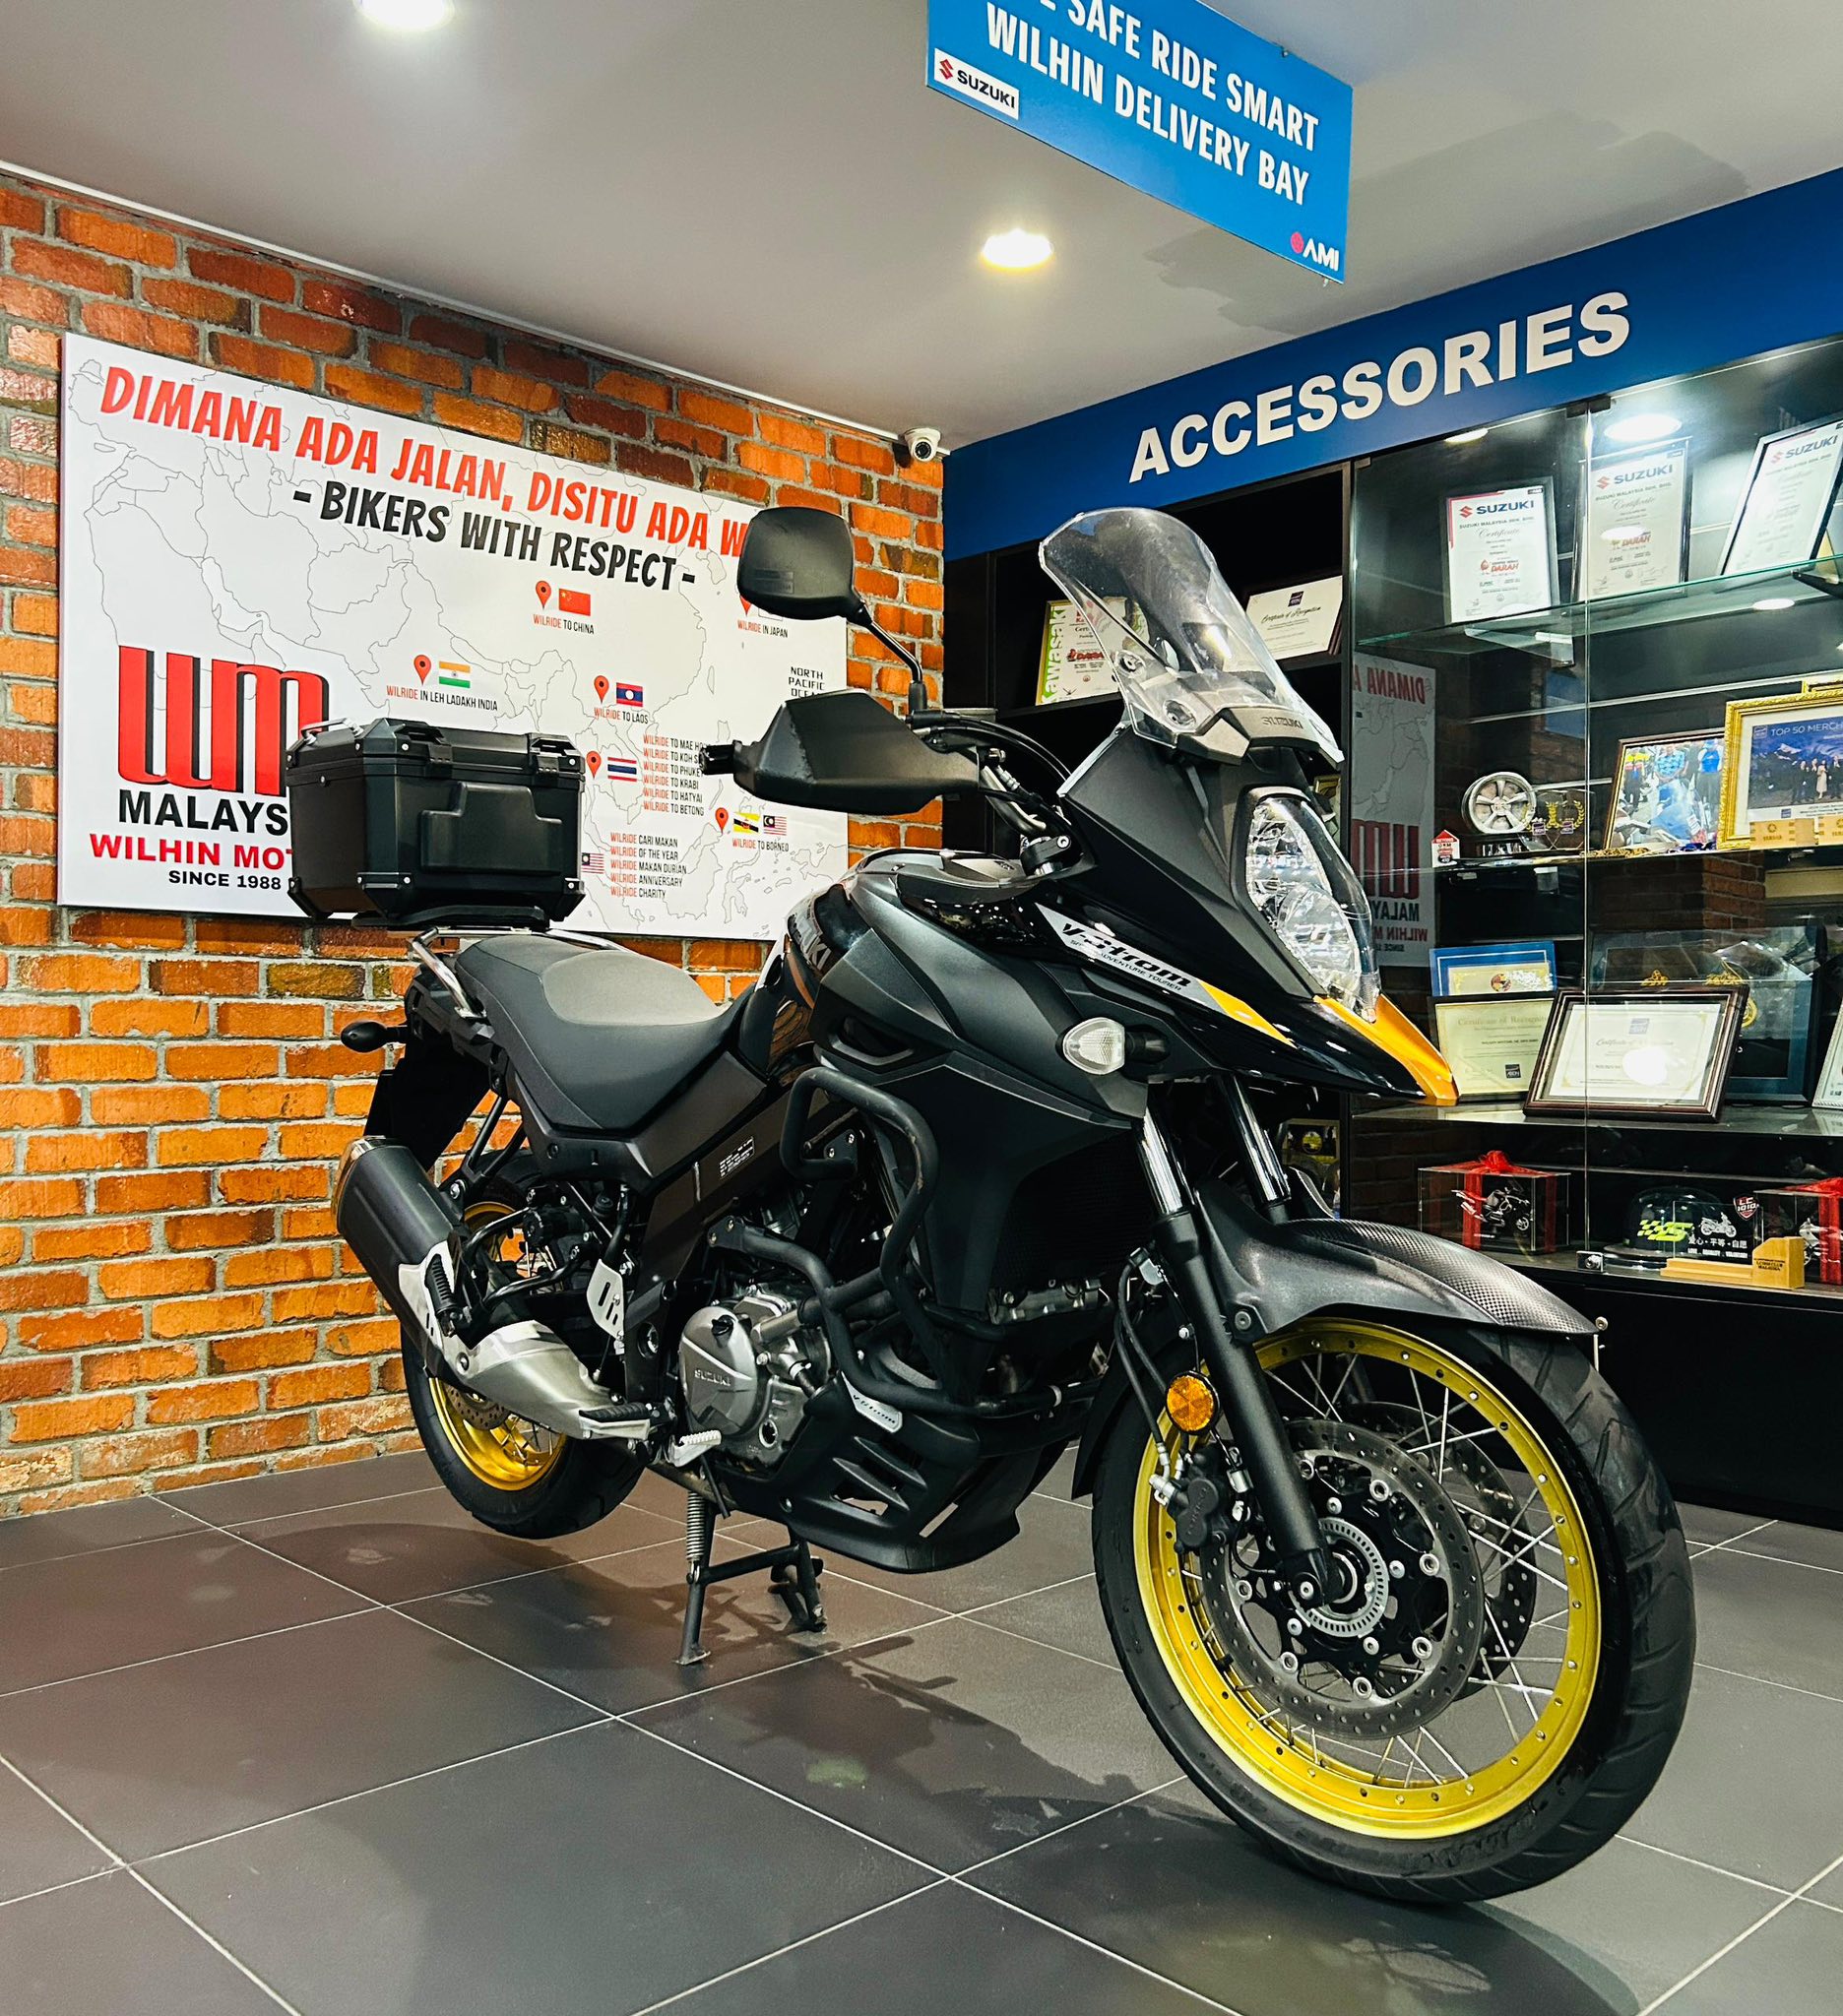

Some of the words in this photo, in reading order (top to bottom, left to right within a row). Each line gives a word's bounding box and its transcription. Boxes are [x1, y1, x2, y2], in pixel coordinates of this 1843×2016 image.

[1067, 0, 1141, 59] SAFE
[1152, 30, 1218, 100] RIDE
[1227, 73, 1319, 151] SMART
[957, 69, 1016, 109] SUZUKI
[986, 2, 1104, 104] WILHIN
[1115, 73, 1250, 177] DELIVERY
[1258, 150, 1309, 205] BAY
[1303, 242, 1340, 272] AMI
[1129, 291, 1630, 483] ACCESSORIES
[1785, 435, 1839, 459] SUZUKI
[99, 366, 283, 452] DIMANA
[295, 416, 378, 473] ADA
[391, 438, 514, 512] JALAN,
[527, 472, 638, 535] DISITU
[646, 502, 708, 550] ADA
[721, 519, 748, 557] W
[1615, 464, 1673, 484] SUZUKI
[1476, 500, 1535, 515] SUZUKI
[320, 480, 450, 542] BIKERS
[461, 511, 542, 562] WITH
[534, 614, 561, 628] WILRIDE
[563, 619, 572, 630] TO
[574, 622, 594, 634] CHINA
[737, 619, 761, 633] WILRIDE
[763, 625, 769, 635] IN
[770, 626, 789, 638] JAPAN
[791, 666, 823, 679] NORTH
[789, 677, 825, 690] PACIFIC
[387, 685, 418, 700] WILRIDE
[420, 690, 428, 701] IN
[430, 692, 445, 703] LEH
[447, 694, 476, 708] LADAKH
[478, 699, 498, 711] INDIA
[792, 688, 819, 697] OCE
[594, 708, 620, 721] WILRIDE
[622, 711, 630, 722] TO
[632, 713, 648, 724] LAOS
[1771, 727, 1790, 736] TOP
[1808, 722, 1843, 732] MERCH
[644, 734, 669, 746] WILRIDE
[670, 738, 678, 748] TO
[680, 739, 693, 750] MAE
[644, 748, 669, 760] WILRIDE
[670, 751, 678, 761] TO
[680, 752, 693, 763] KOH
[644, 762, 669, 774] WILRIDE
[670, 764, 678, 774] TO
[644, 775, 669, 787] WILRIDE
[670, 778, 678, 788] TO
[680, 779, 699, 789] KRABI
[644, 788, 669, 799] WILRIDE
[670, 790, 678, 800] TO
[680, 791, 703, 803] HATYAI
[118, 788, 288, 836] MALAYS
[644, 801, 669, 813] WILRIDE
[670, 803, 678, 813] TO
[680, 804, 704, 816] BETONG
[610, 833, 637, 844] WILRIDE
[639, 835, 654, 845] CARI
[655, 837, 677, 848] MAKAN
[732, 838, 757, 849] WILRIDE
[758, 841, 765, 850] TO
[766, 842, 789, 851] BORNEO
[90, 833, 221, 866] WILHIN
[234, 845, 293, 870] MO
[610, 847, 637, 856] WILRIDE
[639, 848, 647, 857] OF
[649, 849, 660, 859] THE
[662, 850, 678, 860] YEAR
[610, 859, 637, 870] WILRIDE
[639, 861, 662, 872] MAKAN
[664, 863, 686, 874] DURIAN
[168, 870, 229, 886] SINCE
[237, 875, 282, 890] 1988
[610, 873, 637, 884] WILRIDE
[639, 874, 682, 887] ANNIVERSARY
[610, 886, 637, 897] WILRIDE
[639, 888, 666, 898] CHARITY
[1062, 923, 1191, 987] V-Strom
[1149, 974, 1181, 991] TOURER
